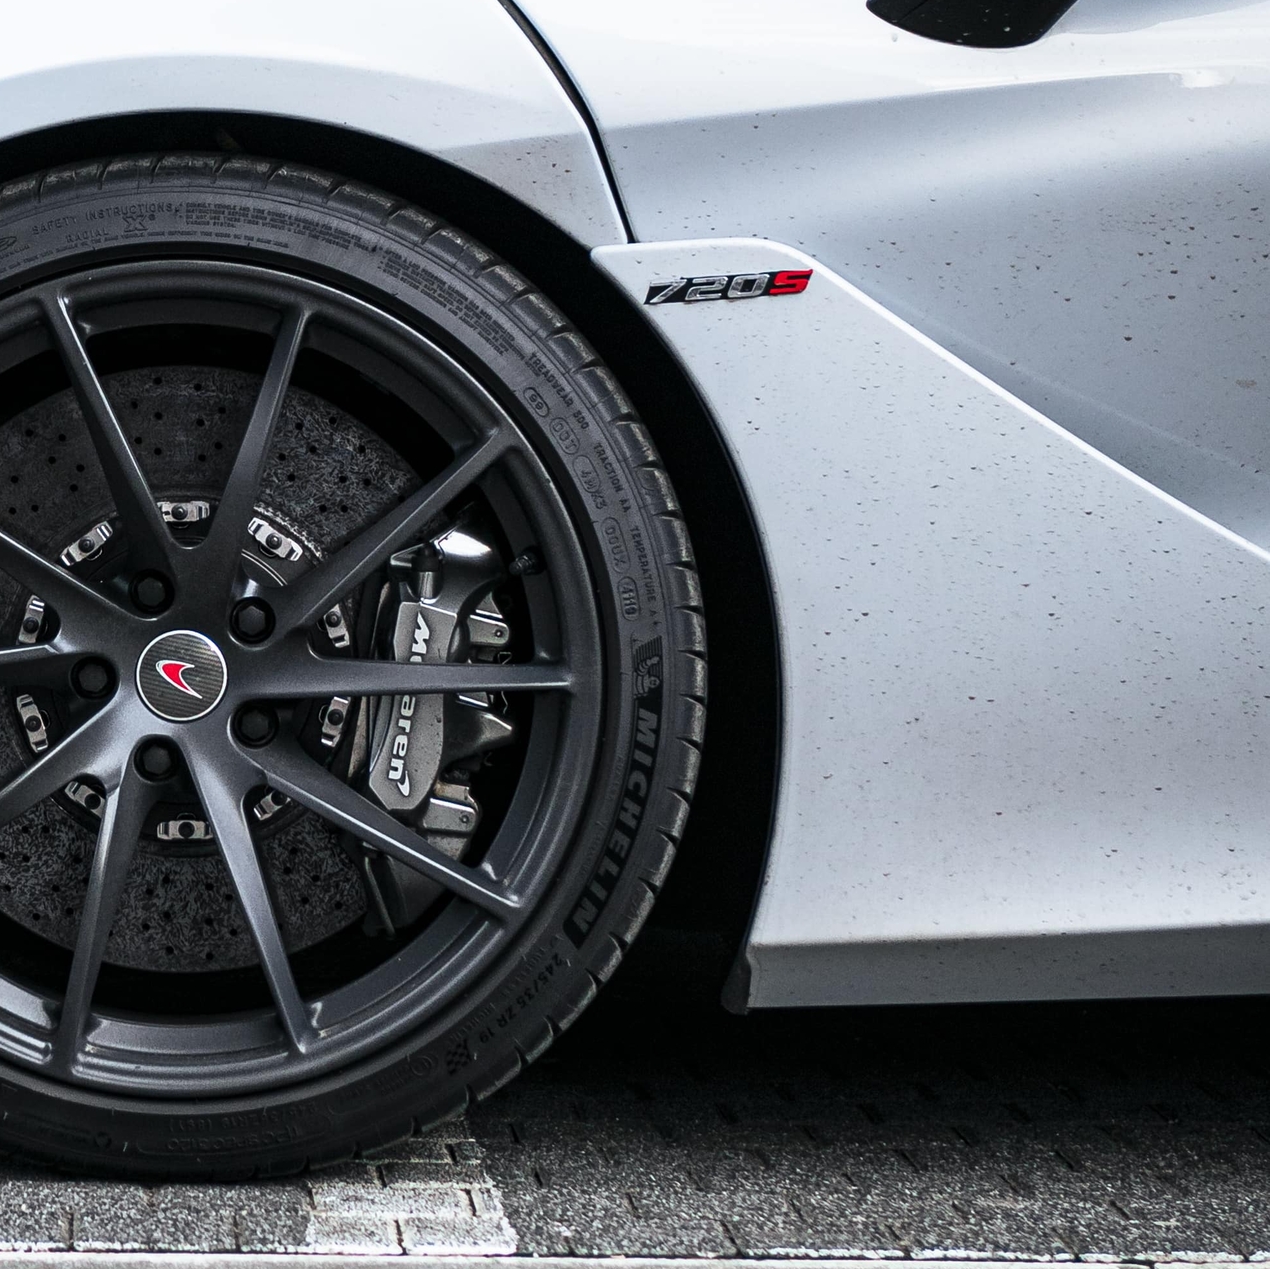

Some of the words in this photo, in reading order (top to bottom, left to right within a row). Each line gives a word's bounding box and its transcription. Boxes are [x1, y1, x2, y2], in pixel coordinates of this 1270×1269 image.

[32, 214, 78, 235] SAFETY
[85, 202, 174, 221] INSTRUCTIONS
[67, 229, 109, 243] RADIAL
[647, 268, 813, 304] 720S
[528, 353, 573, 407] TREADWEAR
[593, 442, 623, 493] TRACTION
[619, 499, 631, 513] AA
[630, 526, 656, 602] TEMPERATURE
[569, 706, 662, 935] MICHELIN
[516, 953, 563, 1008] 245/35
[496, 1006, 516, 1028] ZR
[479, 1027, 495, 1043] 19
